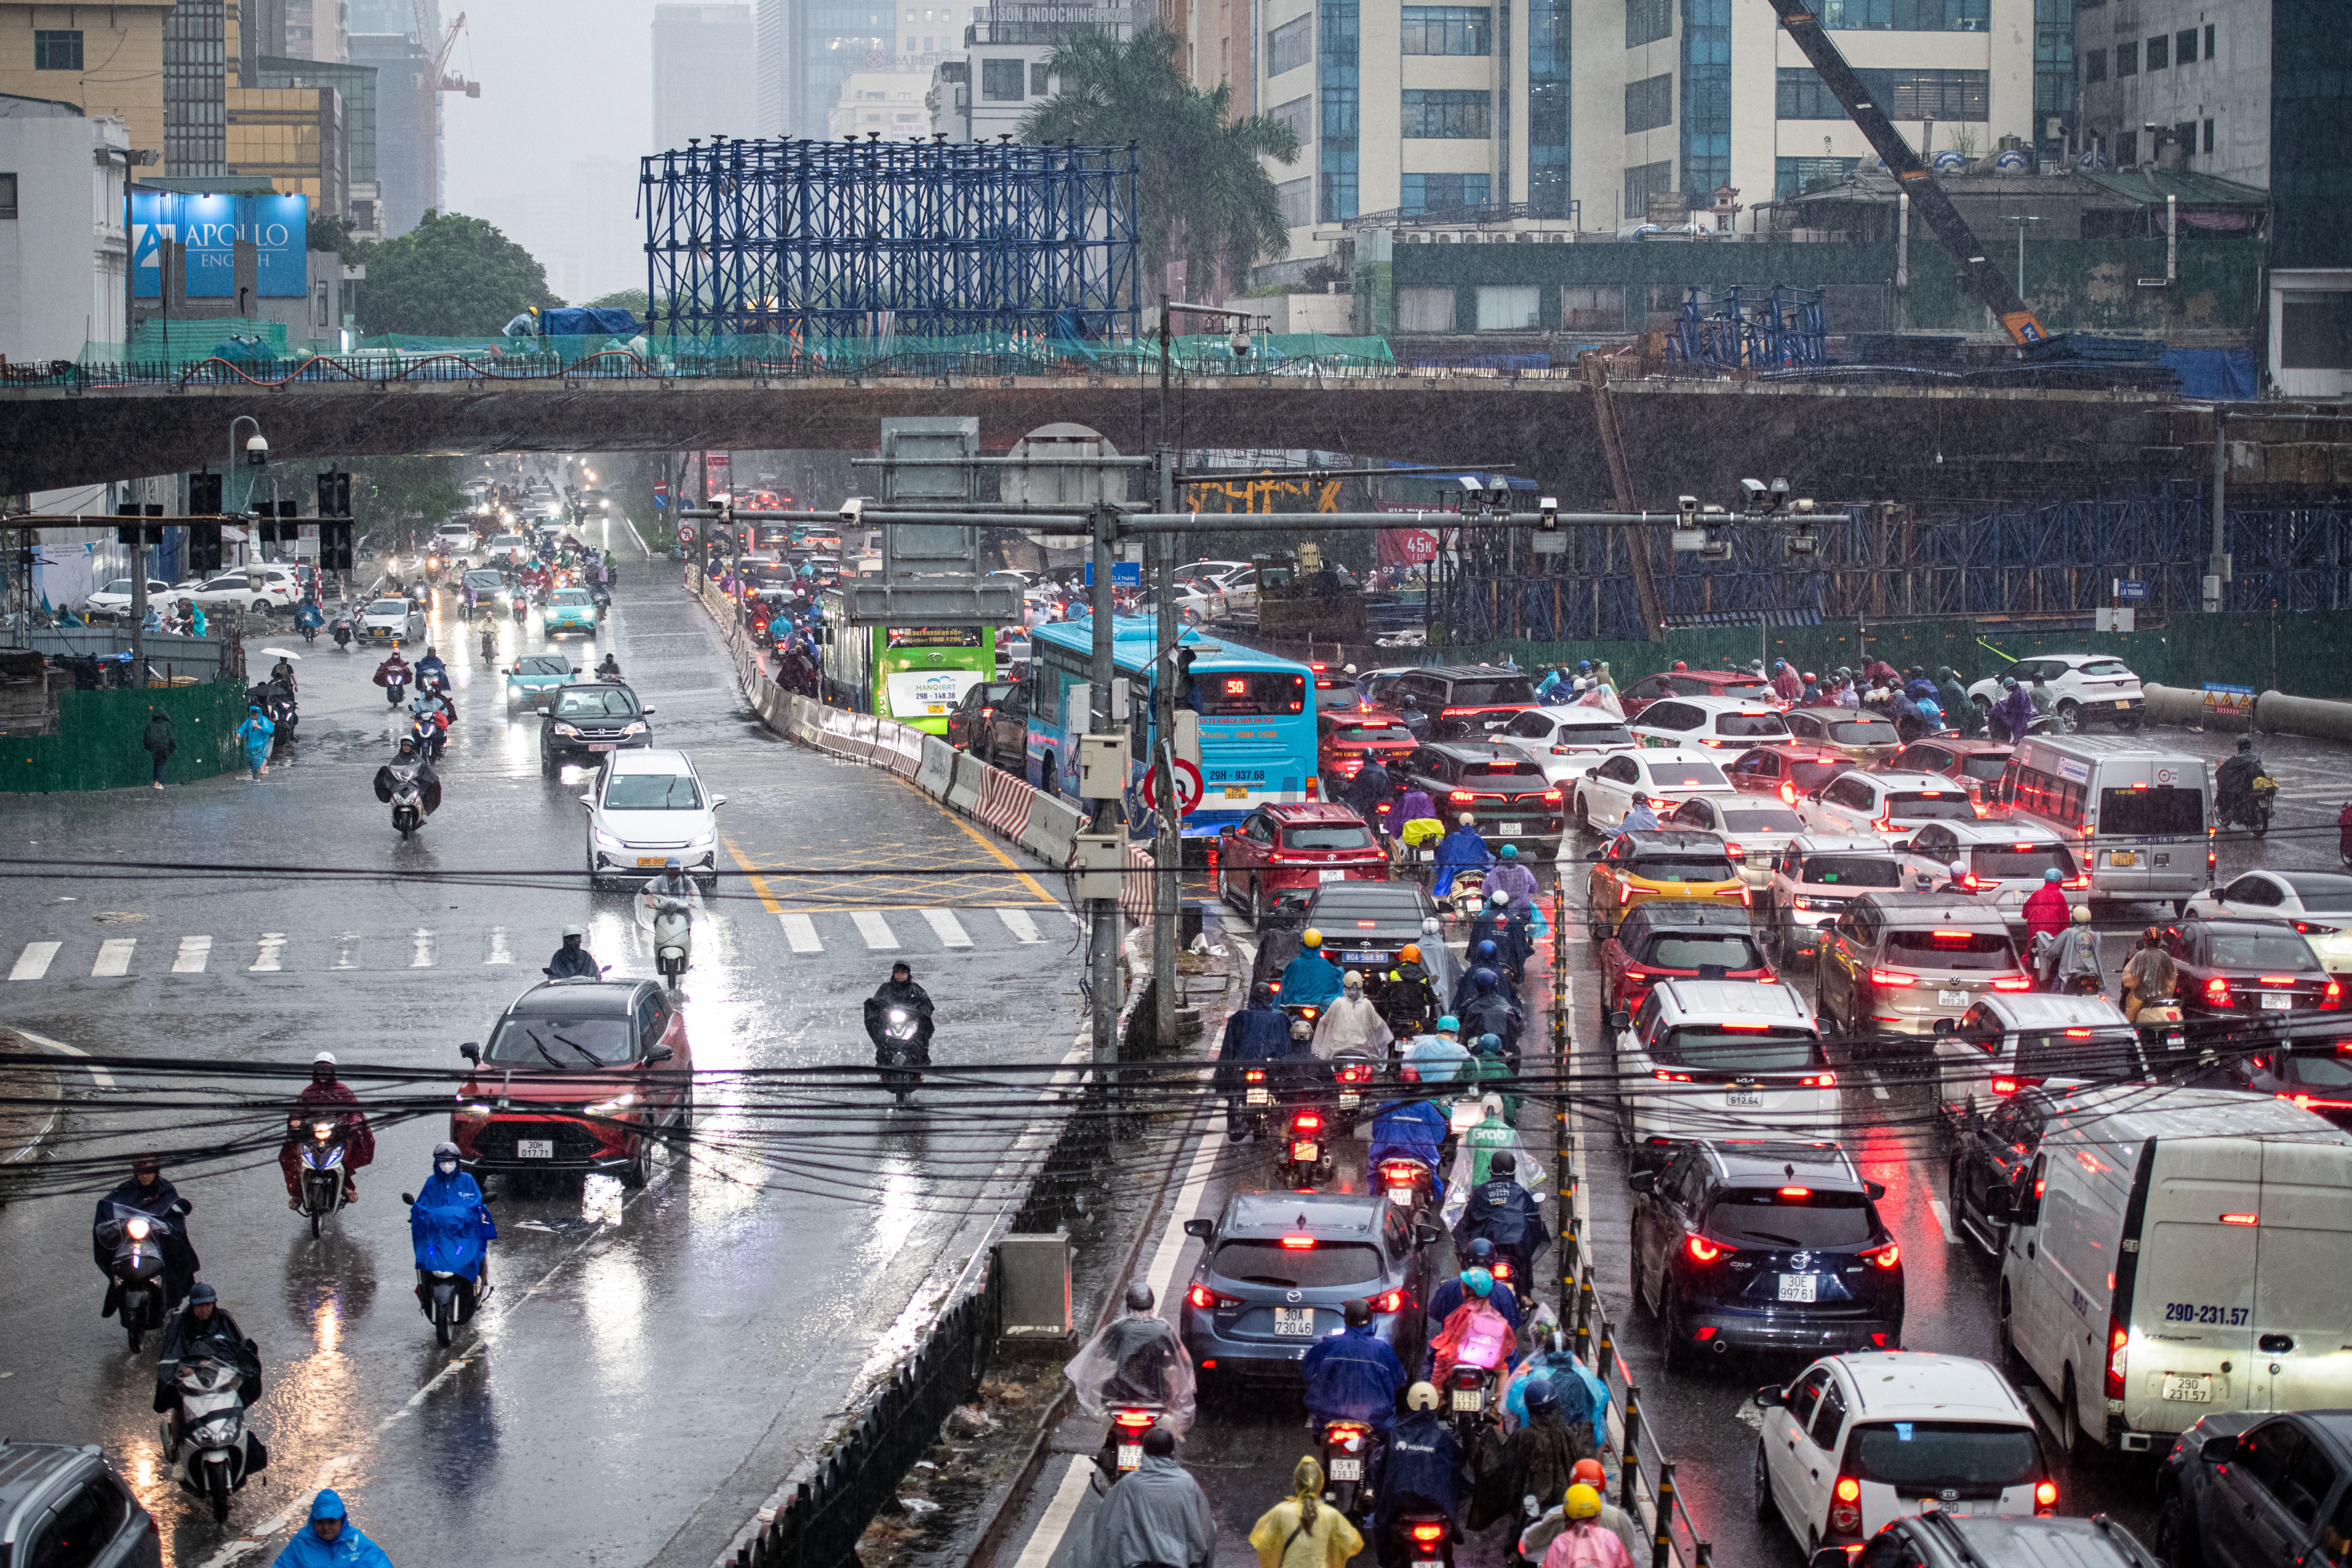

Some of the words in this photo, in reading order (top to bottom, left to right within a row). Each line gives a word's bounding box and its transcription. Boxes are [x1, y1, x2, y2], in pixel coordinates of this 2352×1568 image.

[974, 7, 1022, 22] MAISON
[1028, 7, 1094, 22] INDOCHINE
[885, 54, 942, 65] SeABank
[186, 224, 288, 245] APOLLO
[202, 255, 269, 267] ENGH
[1407, 537, 1432, 553] 45K
[1228, 681, 1244, 693] 50
[1210, 770, 1226, 780] 29H
[1235, 770, 1265, 780] 937.68
[1731, 1097, 1758, 1105] 612.64
[1473, 1128, 1506, 1140] Grab
[1488, 1189, 1509, 1199] with
[1788, 1276, 1807, 1287] 30E
[1780, 1288, 1813, 1299] 997.61
[1284, 1308, 1303, 1321] 30A
[2166, 1302, 2249, 1327] 29D-231.57
[1276, 1322, 1311, 1335] 730.46
[2178, 1378, 2198, 1389] 29D
[2169, 1389, 2207, 1401] 231.57
[1408, 1444, 1435, 1453] HUAWE
[1120, 1457, 1139, 1466] 923.8
